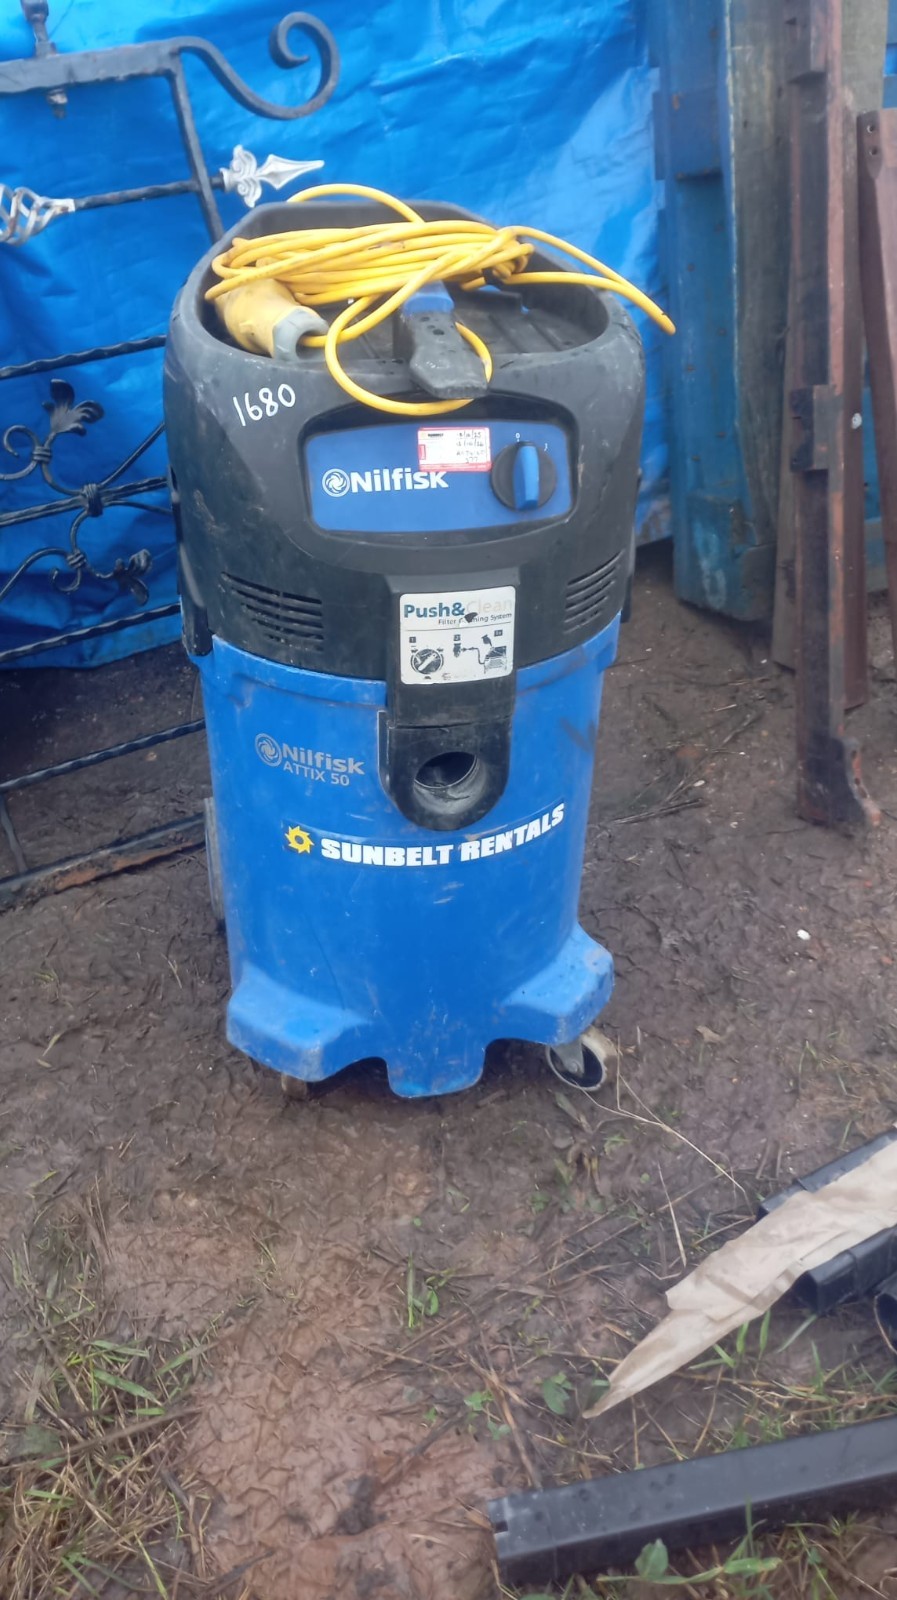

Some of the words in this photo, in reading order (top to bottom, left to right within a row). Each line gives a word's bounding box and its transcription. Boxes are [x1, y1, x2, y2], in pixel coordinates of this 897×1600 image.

[232, 383, 296, 427] 1680
[351, 468, 449, 493] Nilfisk
[490, 613, 513, 622] System
[282, 743, 366, 775] Nilfisk
[283, 760, 326, 782] ATTIX
[330, 773, 350, 786] 50
[321, 838, 454, 867] SUNBELT
[460, 803, 565, 862] RENTALS
